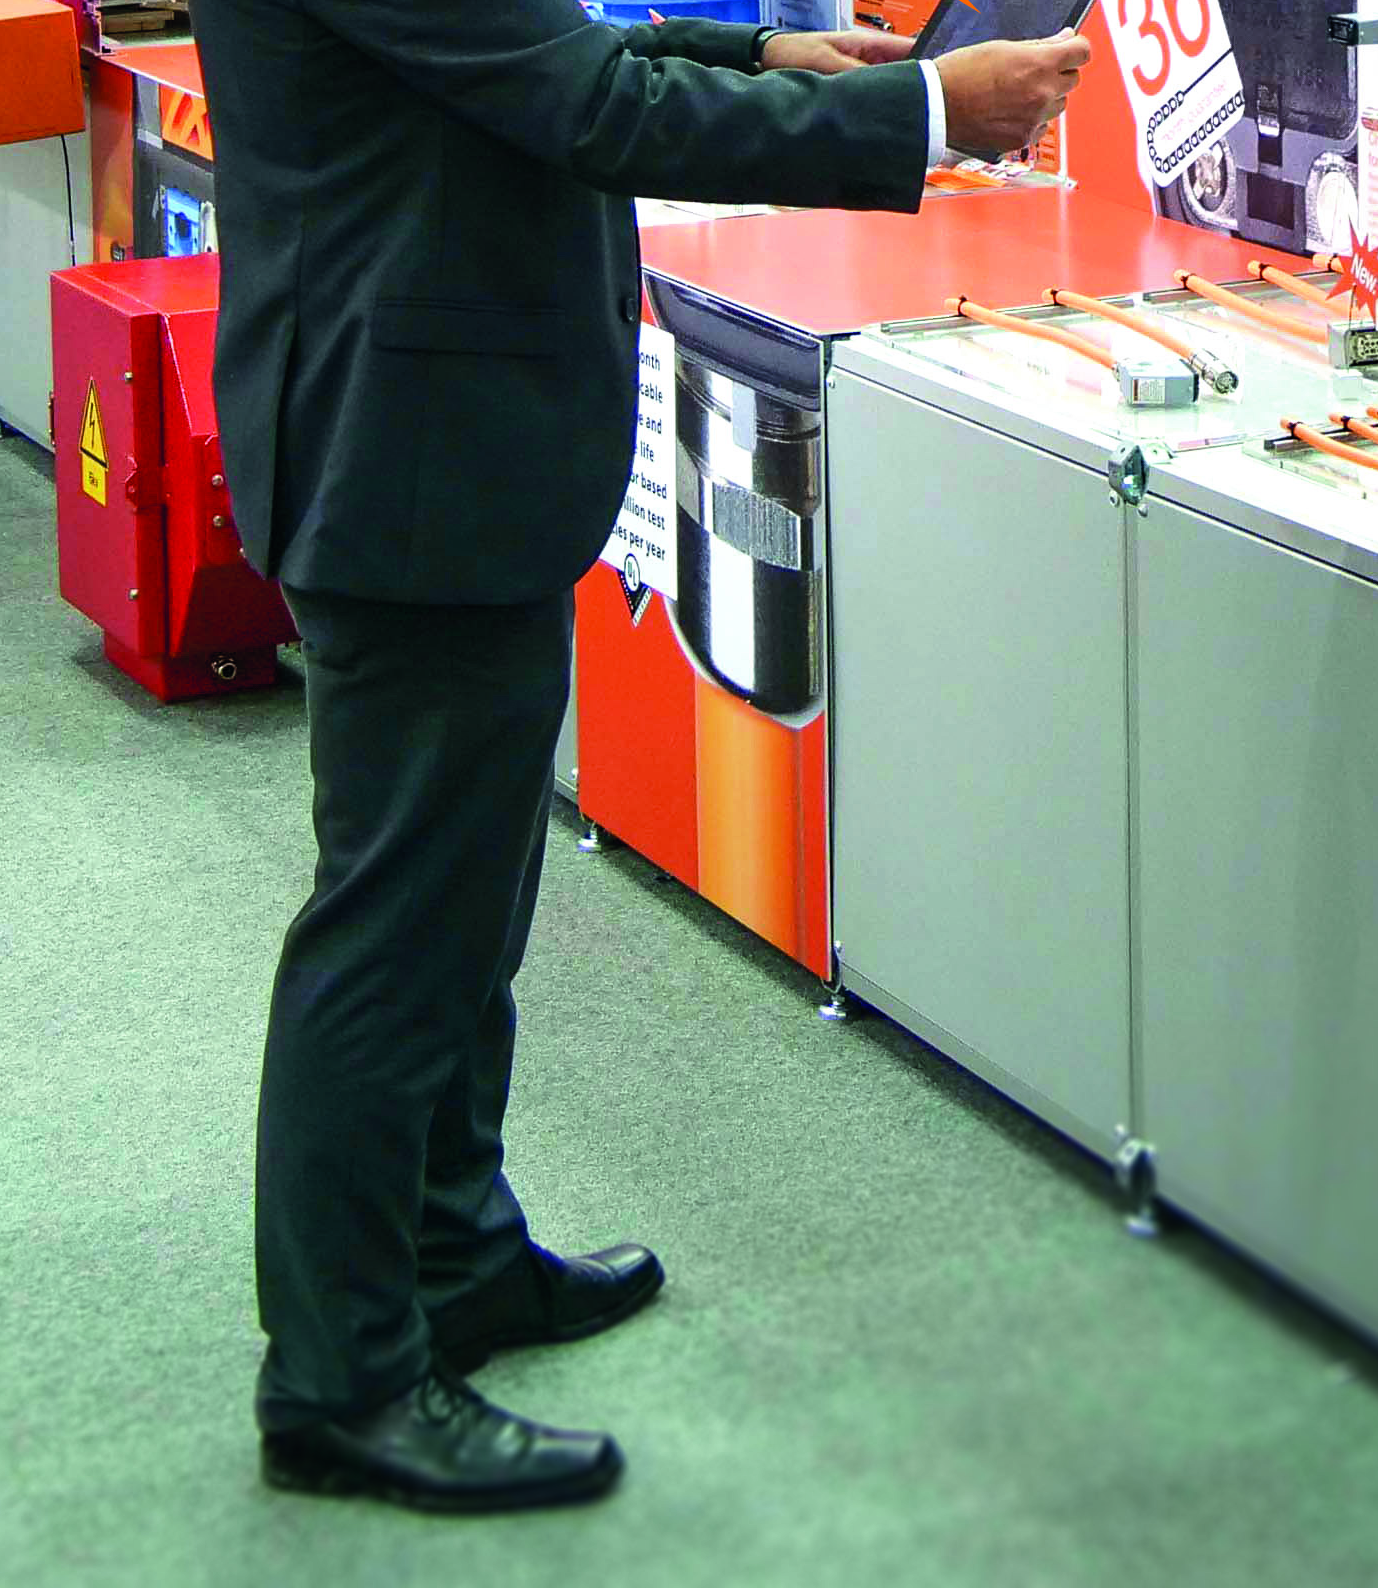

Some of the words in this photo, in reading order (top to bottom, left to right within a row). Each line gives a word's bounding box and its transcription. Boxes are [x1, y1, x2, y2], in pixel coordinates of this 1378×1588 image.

[1351, 254, 1377, 295] New.
[640, 444, 654, 462] life
[641, 474, 667, 499] based
